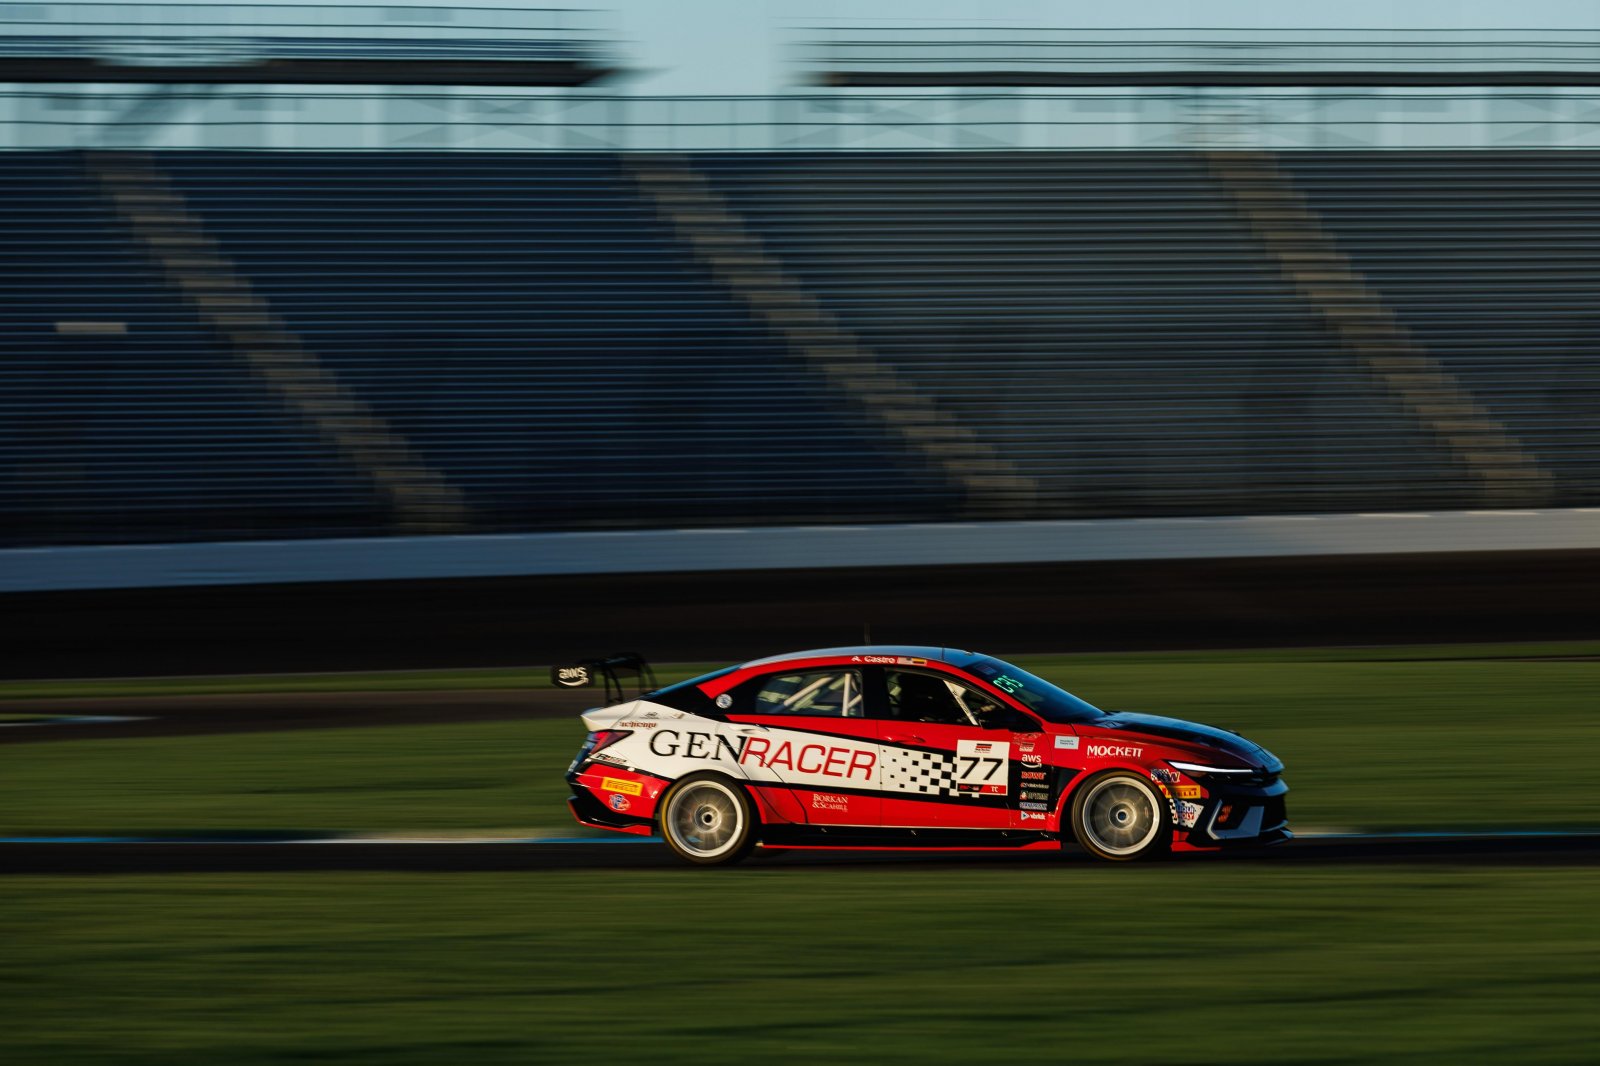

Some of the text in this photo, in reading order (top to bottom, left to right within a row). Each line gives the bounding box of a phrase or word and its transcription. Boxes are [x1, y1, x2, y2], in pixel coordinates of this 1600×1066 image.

[864, 655, 896, 665] Castro
[558, 666, 588, 679] aws
[1086, 745, 1144, 758] MOCKETT
[1021, 753, 1042, 763] aws
[959, 756, 1004, 781] 77
[813, 793, 849, 804] BORKAN
